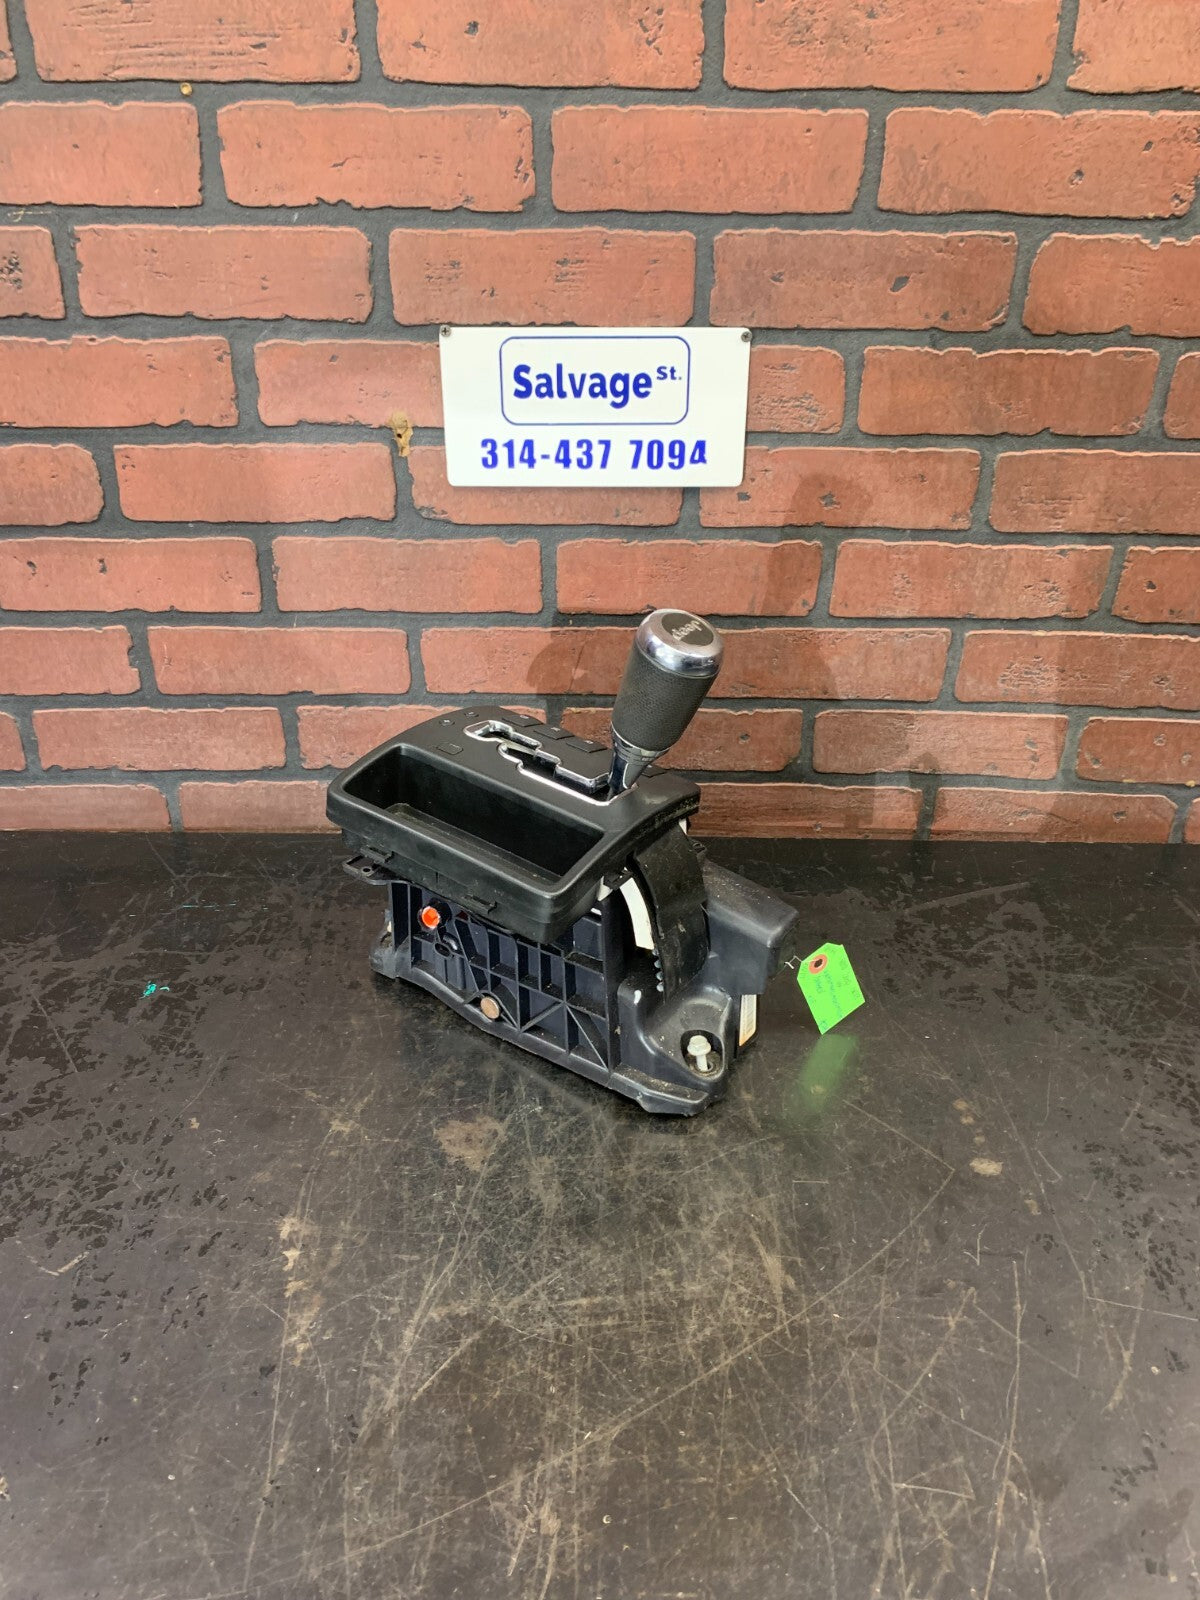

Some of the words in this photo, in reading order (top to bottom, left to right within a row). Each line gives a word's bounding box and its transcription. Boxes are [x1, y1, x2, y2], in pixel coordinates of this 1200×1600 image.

[513, 363, 652, 409] Salvage
[656, 366, 682, 381] St.
[481, 438, 612, 469] 314-437
[629, 439, 707, 469] 7094
